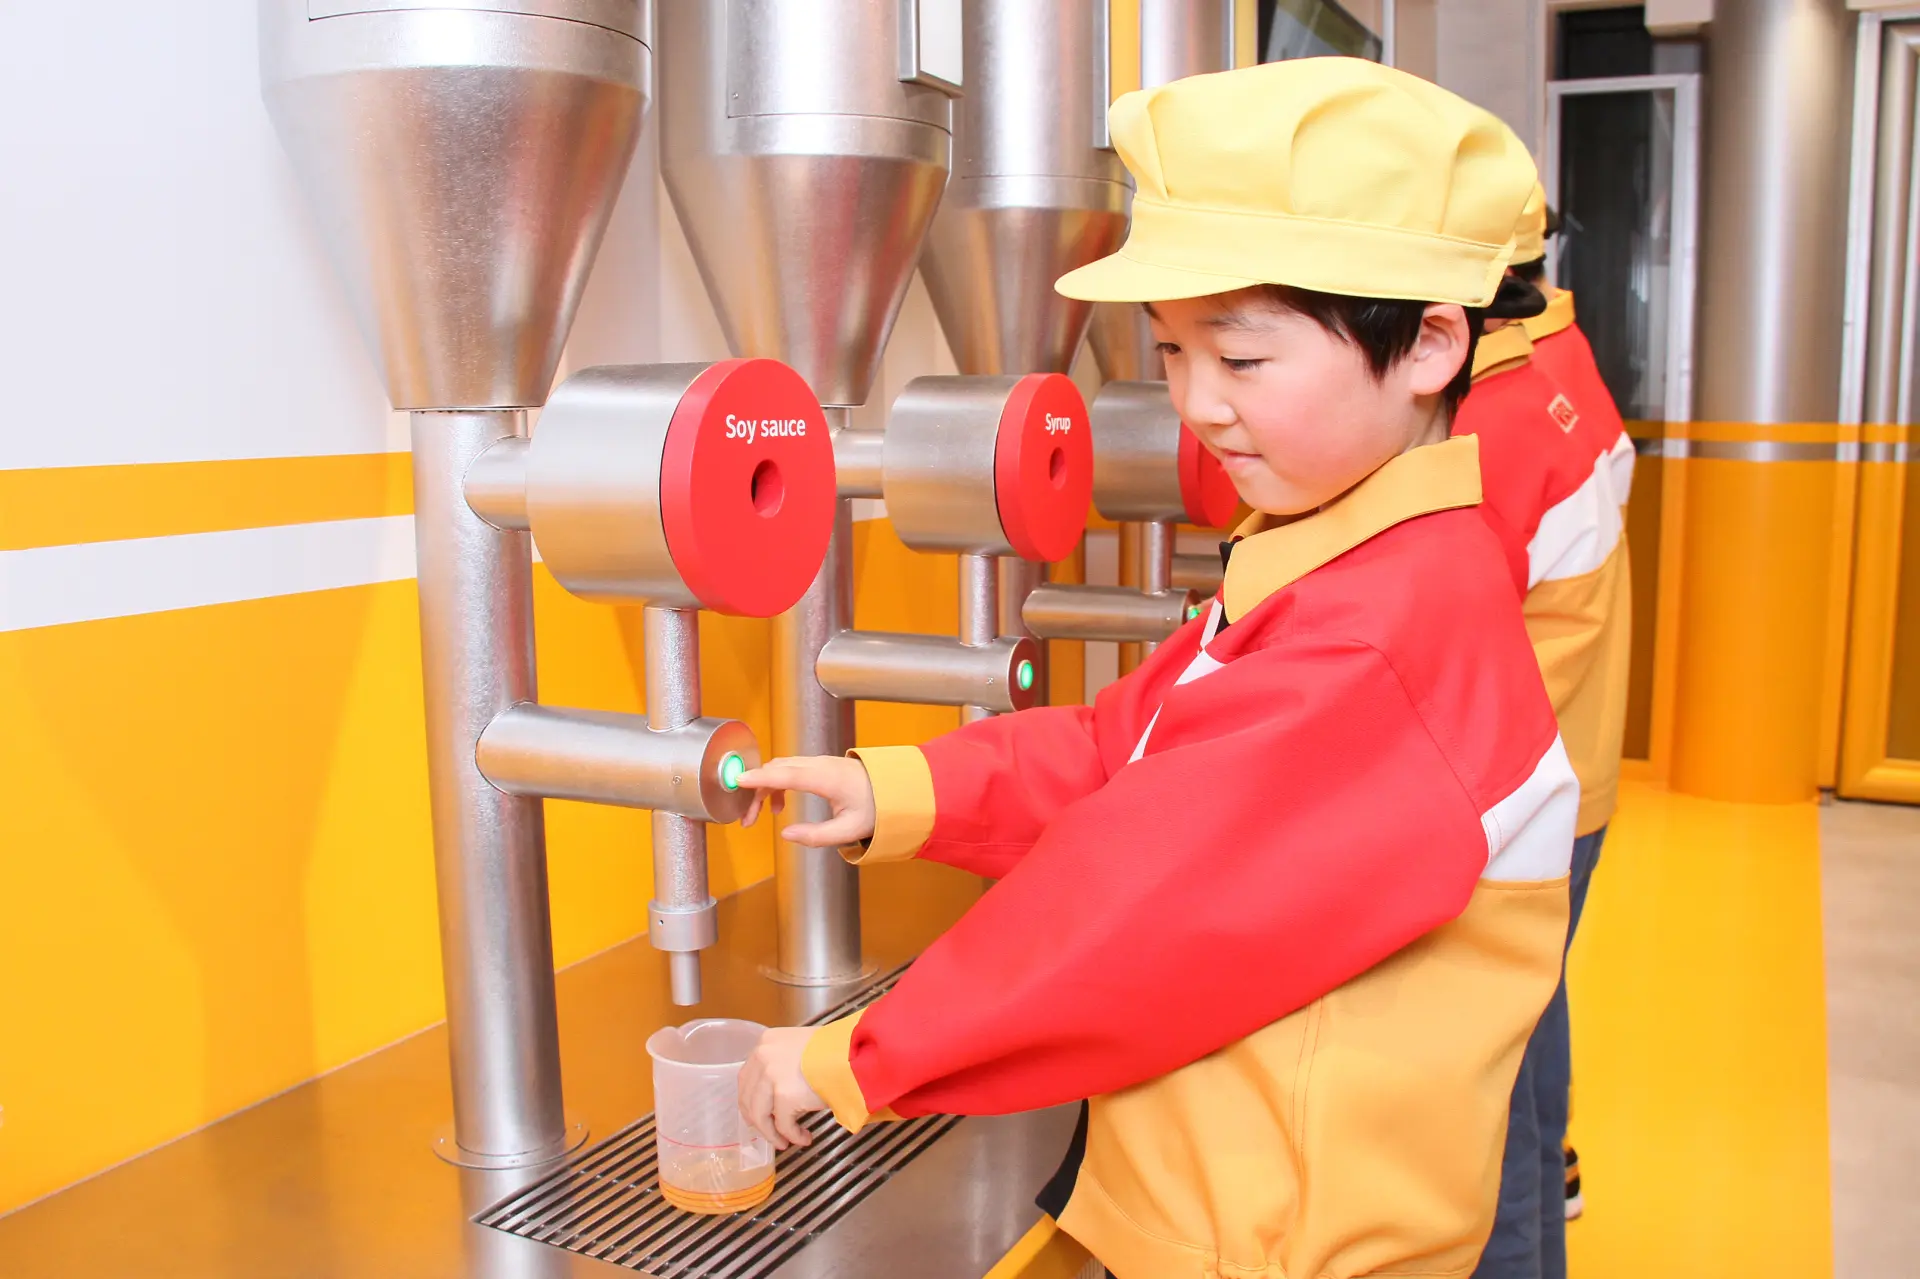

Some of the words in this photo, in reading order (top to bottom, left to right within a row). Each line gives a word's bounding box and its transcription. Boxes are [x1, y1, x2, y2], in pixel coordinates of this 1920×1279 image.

[726, 414, 757, 444] Soy
[761, 419, 806, 437] sauce
[1045, 412, 1071, 435] Syrup
